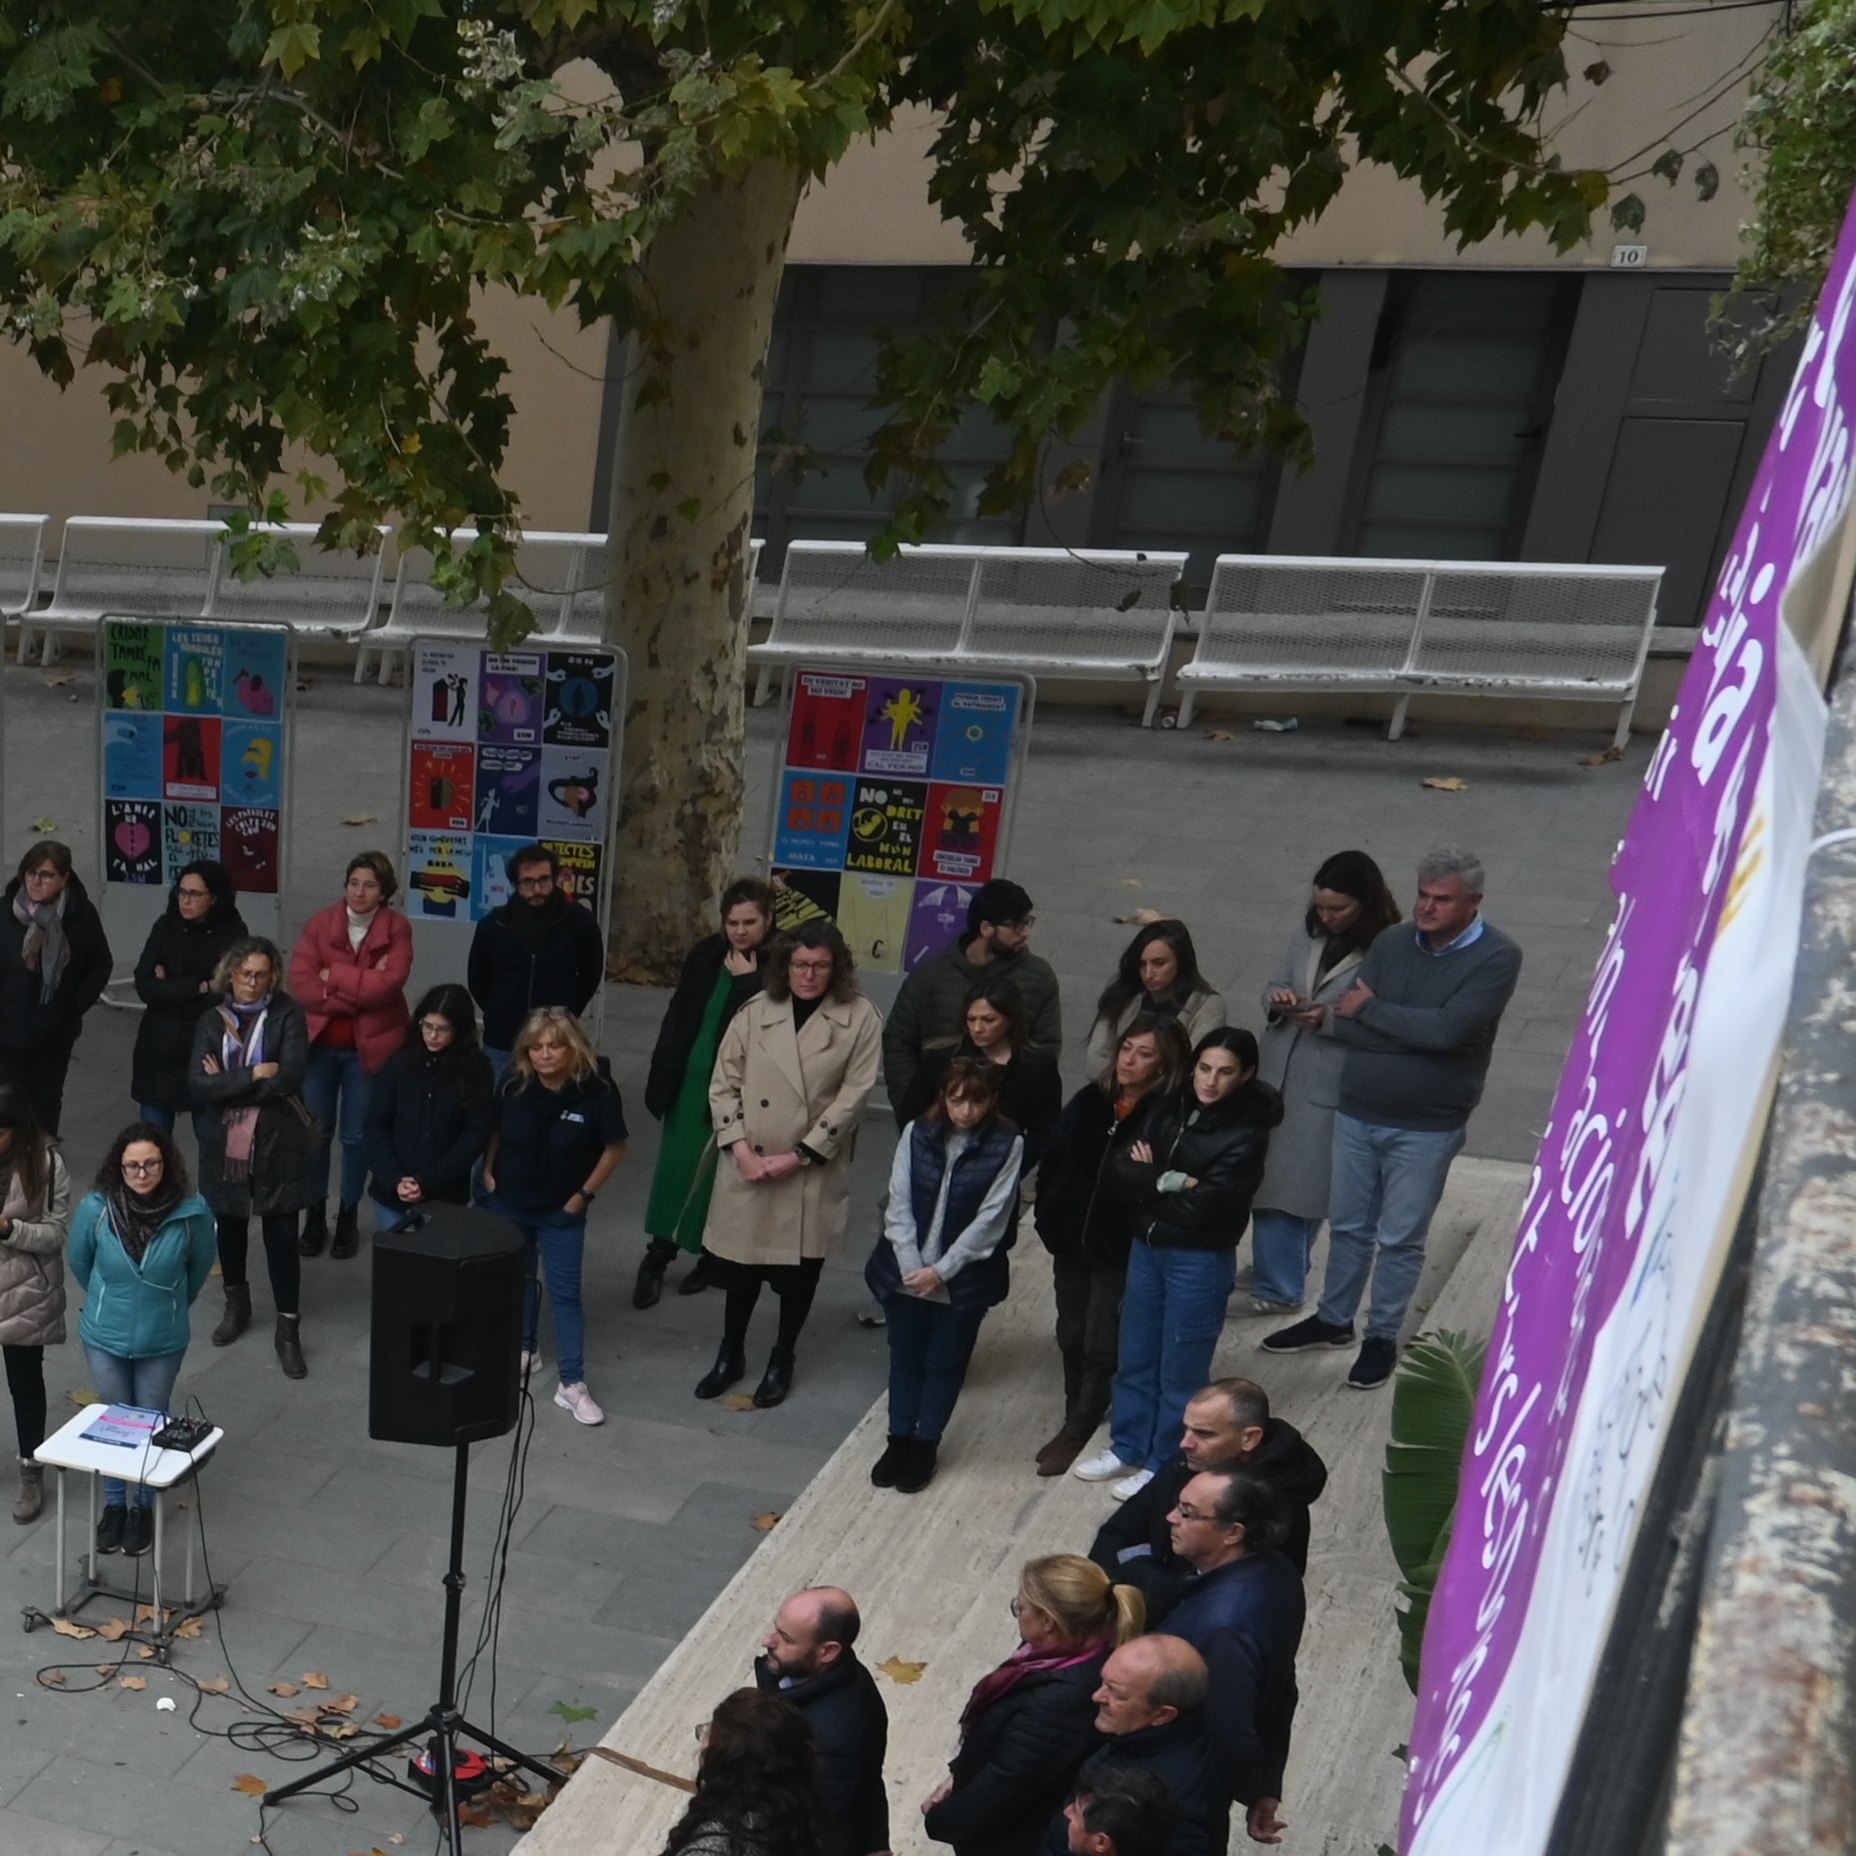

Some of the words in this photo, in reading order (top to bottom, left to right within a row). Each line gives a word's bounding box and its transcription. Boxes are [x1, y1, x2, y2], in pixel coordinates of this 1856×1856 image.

[1620, 250, 1639, 264] 10
[859, 787, 888, 806] NO
[846, 852, 913, 874] LABORAL
